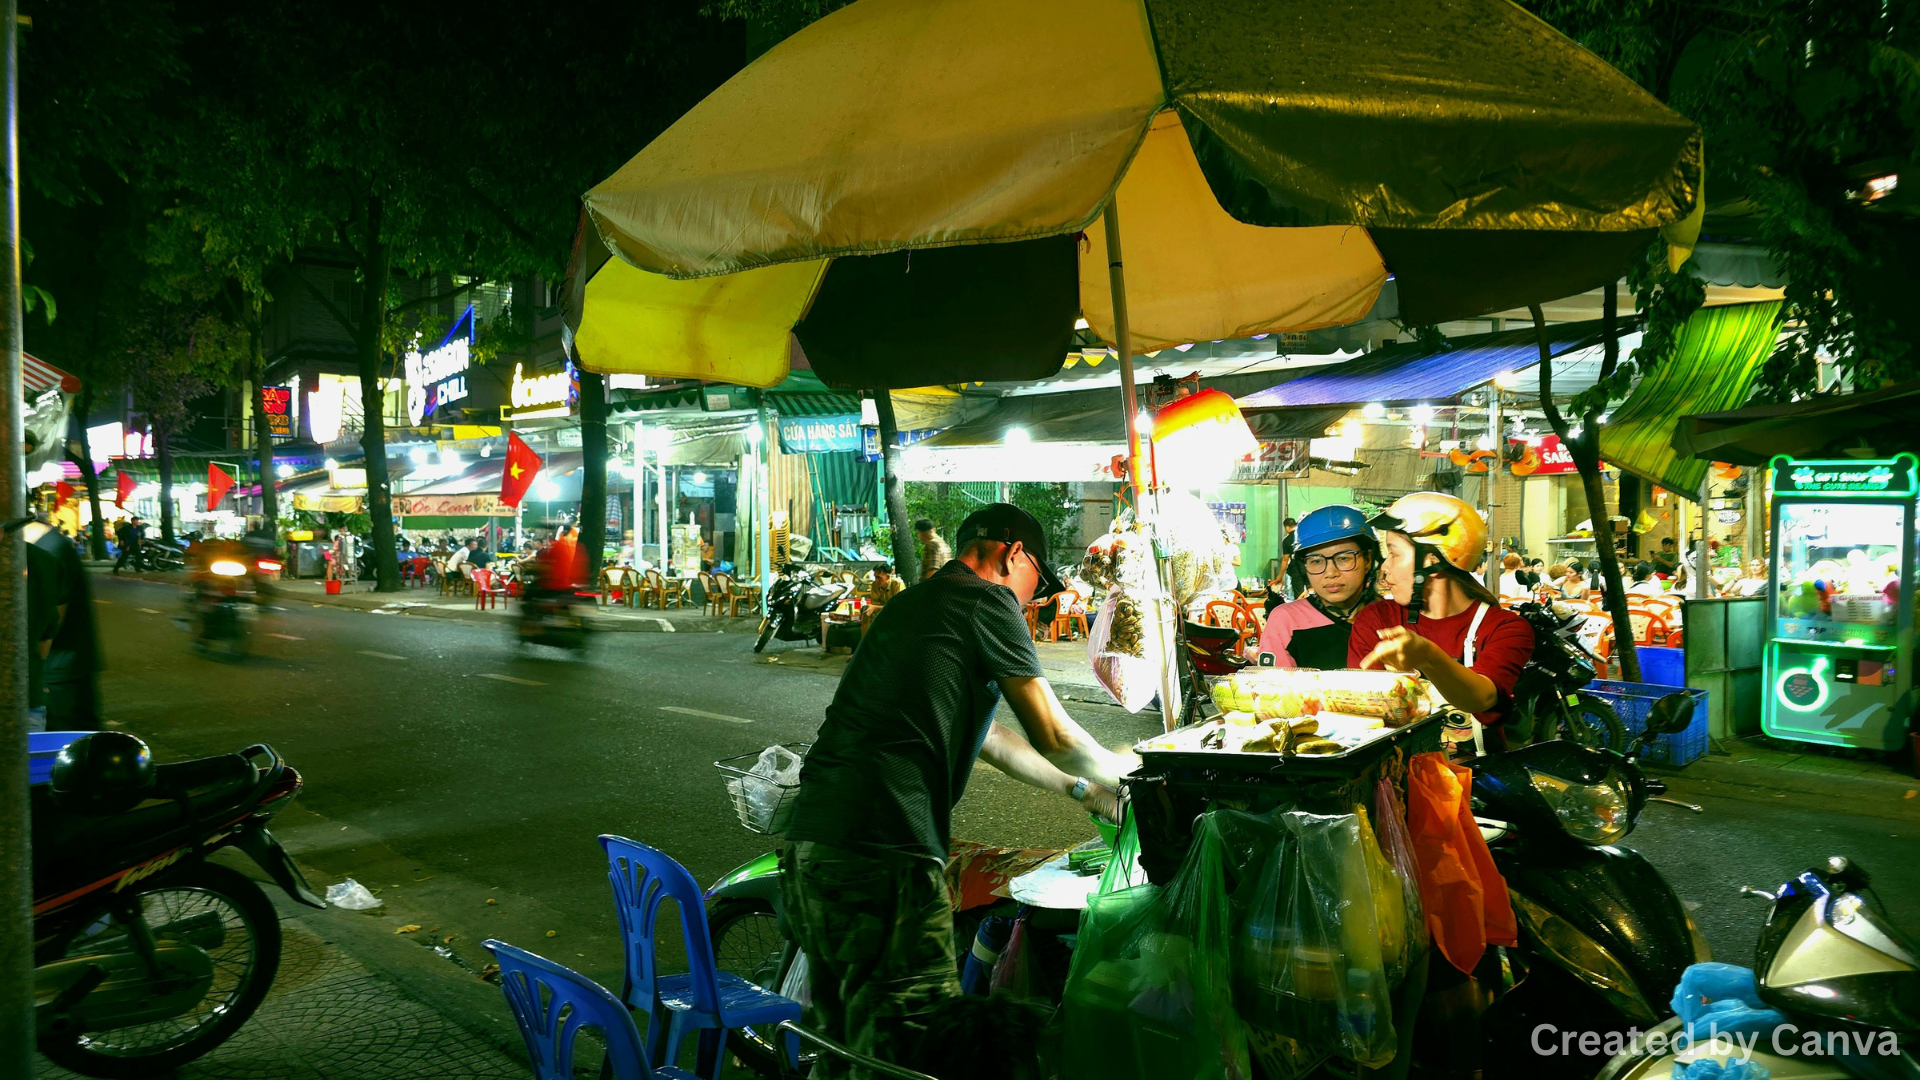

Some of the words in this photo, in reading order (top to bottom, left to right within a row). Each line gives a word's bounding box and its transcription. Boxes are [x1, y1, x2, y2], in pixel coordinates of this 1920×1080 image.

[436, 375, 469, 406] CHILL
[783, 421, 806, 441] CỬA
[806, 421, 836, 441] HÀNG
[838, 418, 858, 438] SẮT
[1542, 451, 1575, 464] SAIG
